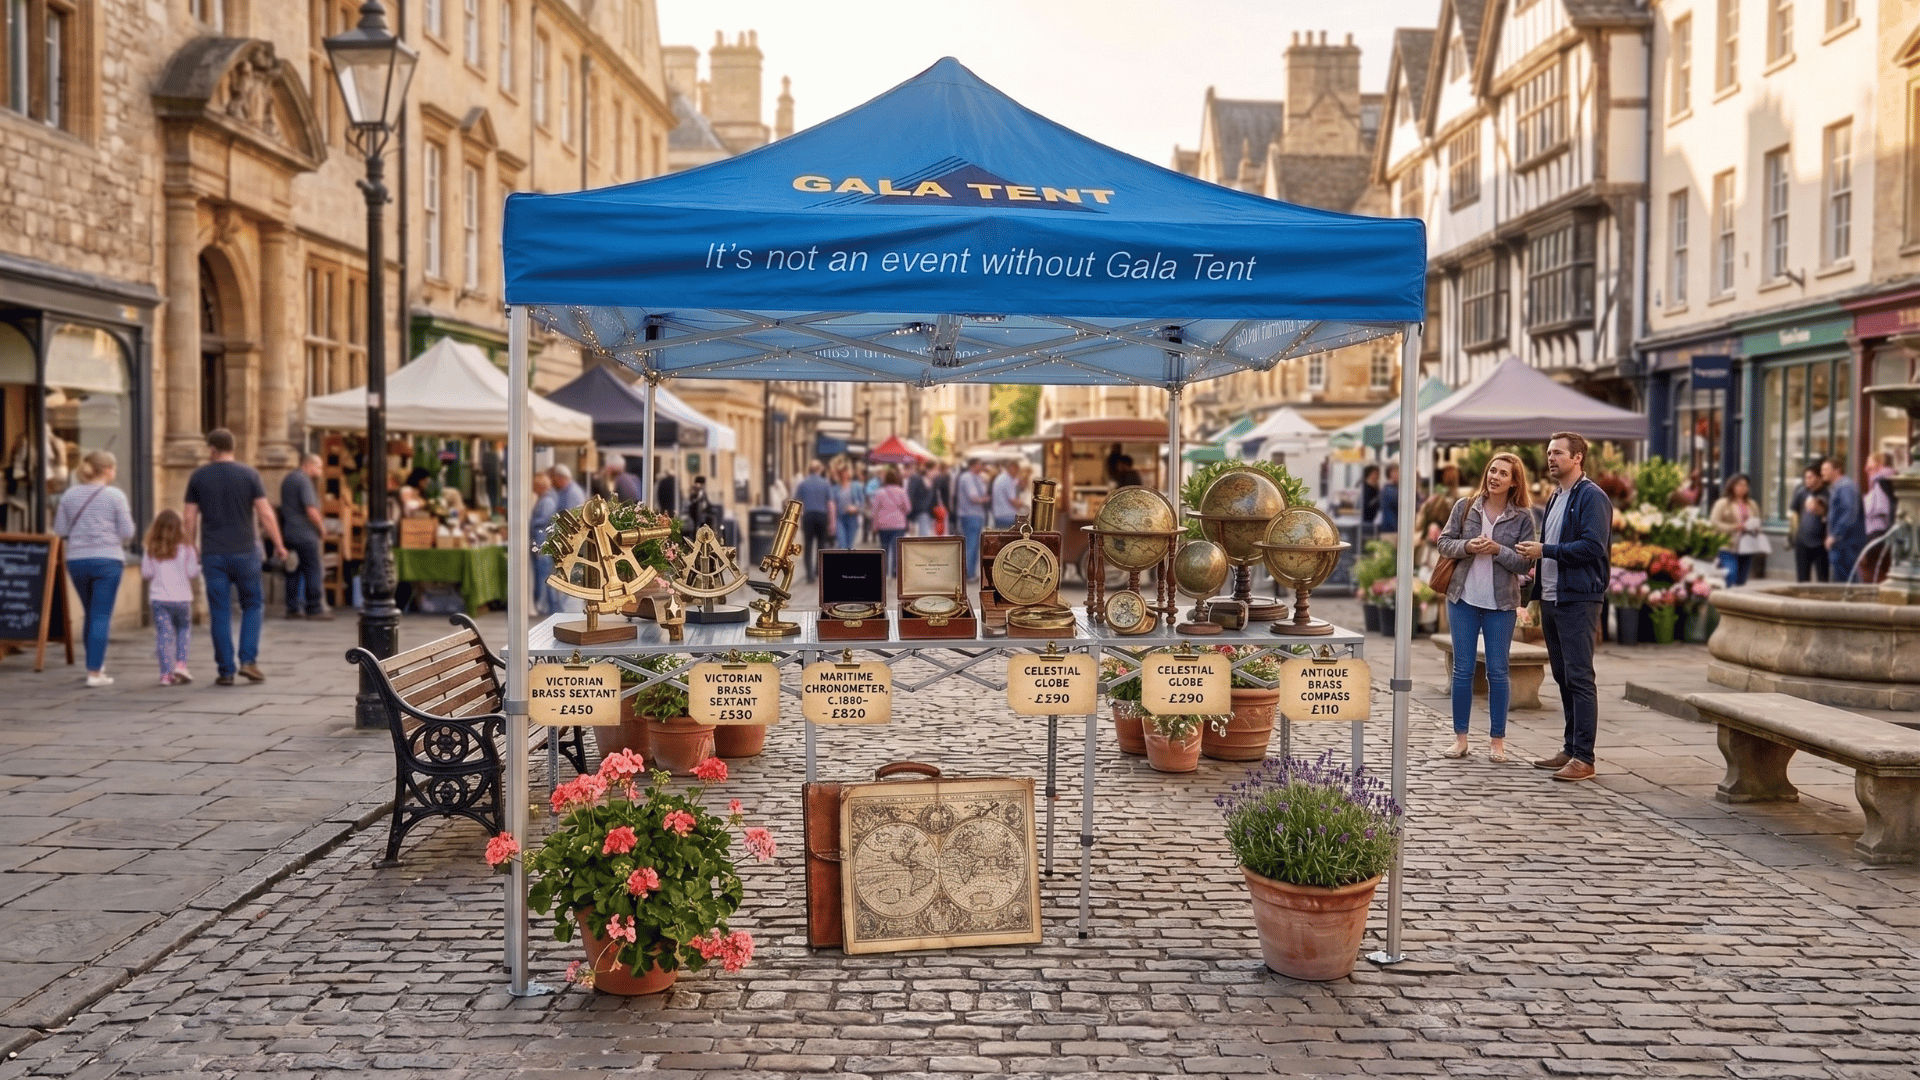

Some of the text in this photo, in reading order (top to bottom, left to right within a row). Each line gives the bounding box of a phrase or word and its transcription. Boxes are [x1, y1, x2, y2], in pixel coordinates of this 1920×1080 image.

[792, 175, 1116, 204] GALA TENT
[766, 245, 819, 271] not
[828, 250, 868, 272] an
[881, 247, 971, 274] event
[982, 247, 1096, 278] without
[1106, 251, 1177, 280] Gala
[1192, 253, 1257, 281] Tent
[1024, 666, 1080, 676] CELESTIAL
[1157, 665, 1214, 675] CELESTIAL
[1301, 668, 1349, 678] ANTIQUE
[546, 677, 603, 686] VICTORIAN
[705, 674, 762, 683] VICTORIAN
[820, 672, 874, 681] MARITIME
[1034, 679, 1070, 688] GLOBE
[1168, 677, 1203, 687] GLOBE
[1308, 680, 1342, 689] BRASS
[532, 689, 617, 698] BRASS SEXTANT
[717, 686, 751, 695] BRASS
[805, 684, 888, 695] CHRONOMETER,
[710, 697, 758, 706] SEXTANT
[1169, 694, 1204, 704] £290
[1301, 692, 1350, 701] COMPASS
[560, 705, 593, 715] £450
[832, 709, 866, 718] £820
[1311, 704, 1339, 715] £110
[719, 710, 753, 720] £530
